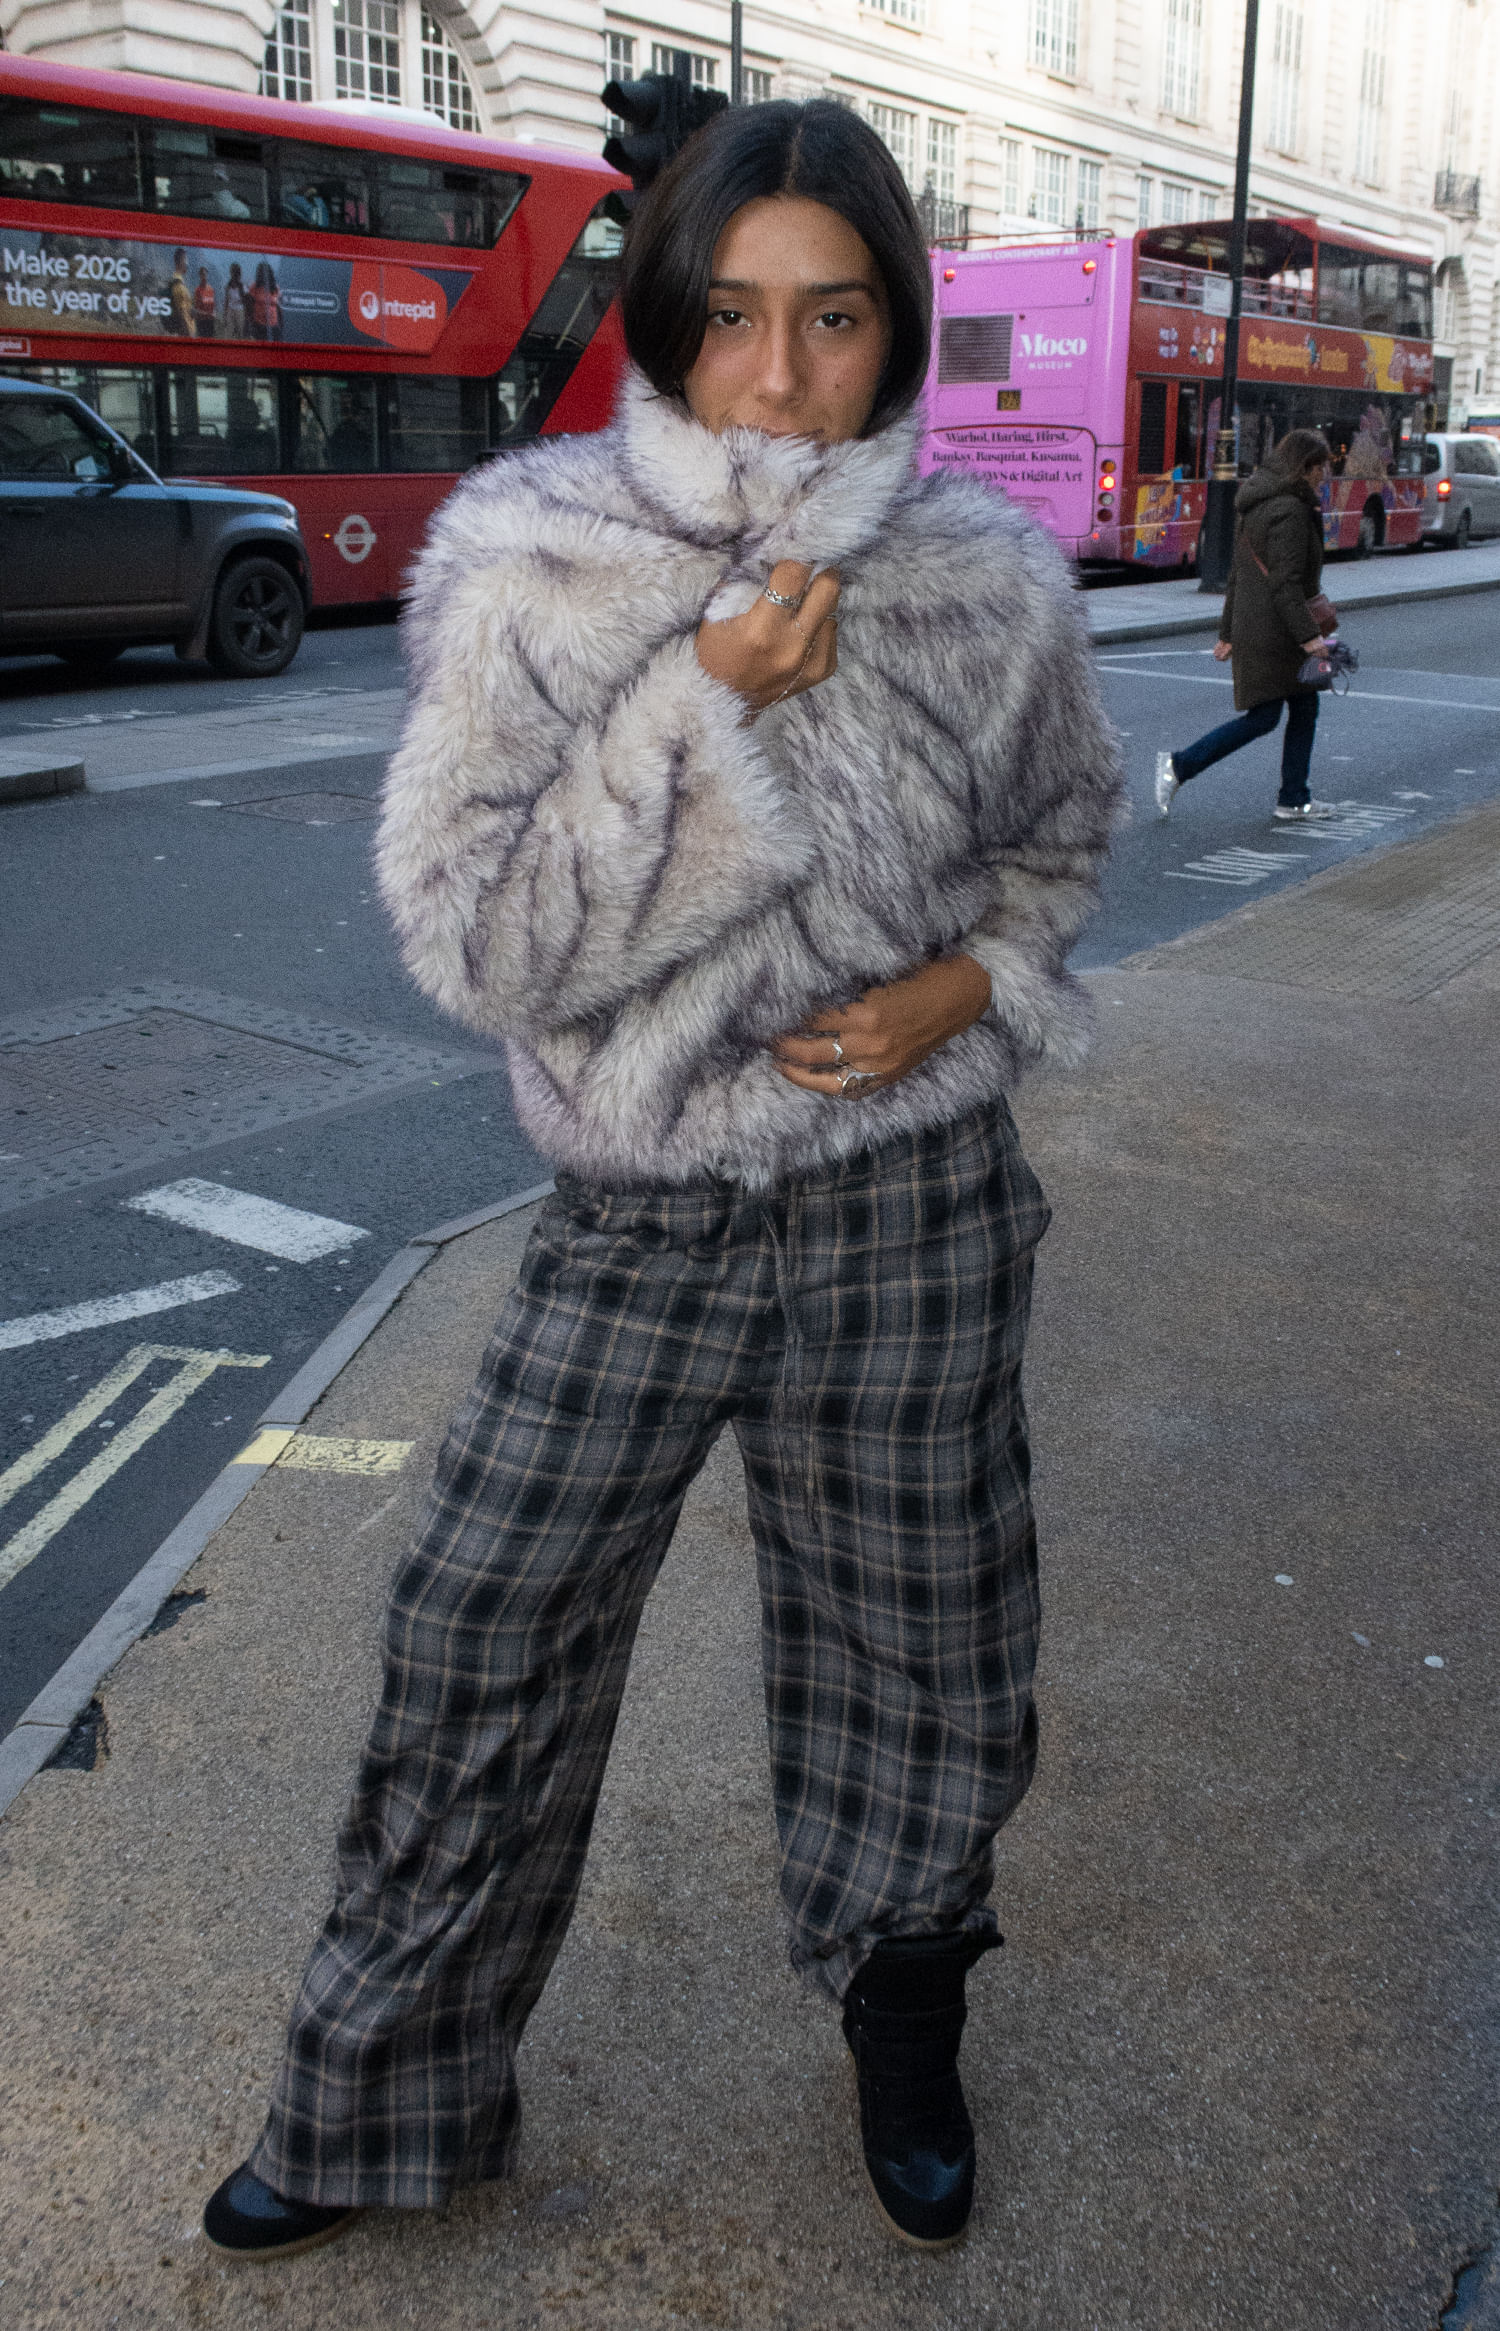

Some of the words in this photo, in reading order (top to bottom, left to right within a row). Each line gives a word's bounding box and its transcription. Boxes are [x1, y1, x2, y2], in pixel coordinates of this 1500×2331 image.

[3, 248, 70, 277] Make
[74, 254, 132, 283] 2026
[5, 281, 47, 308] the
[51, 287, 102, 316] year
[107, 289, 131, 313] of
[135, 296, 173, 321] yes
[1017, 333, 1088, 357] Moco
[1028, 361, 1072, 370] MUSEUM
[946, 431, 990, 443] Warhol,
[992, 431, 1034, 443] Haring,
[1036, 430, 1069, 442] Hirst,
[1009, 472, 1020, 481] &
[1021, 470, 1060, 482] Digital
[1062, 471, 1083, 482] Art
[1163, 846, 1312, 886] LOOK
